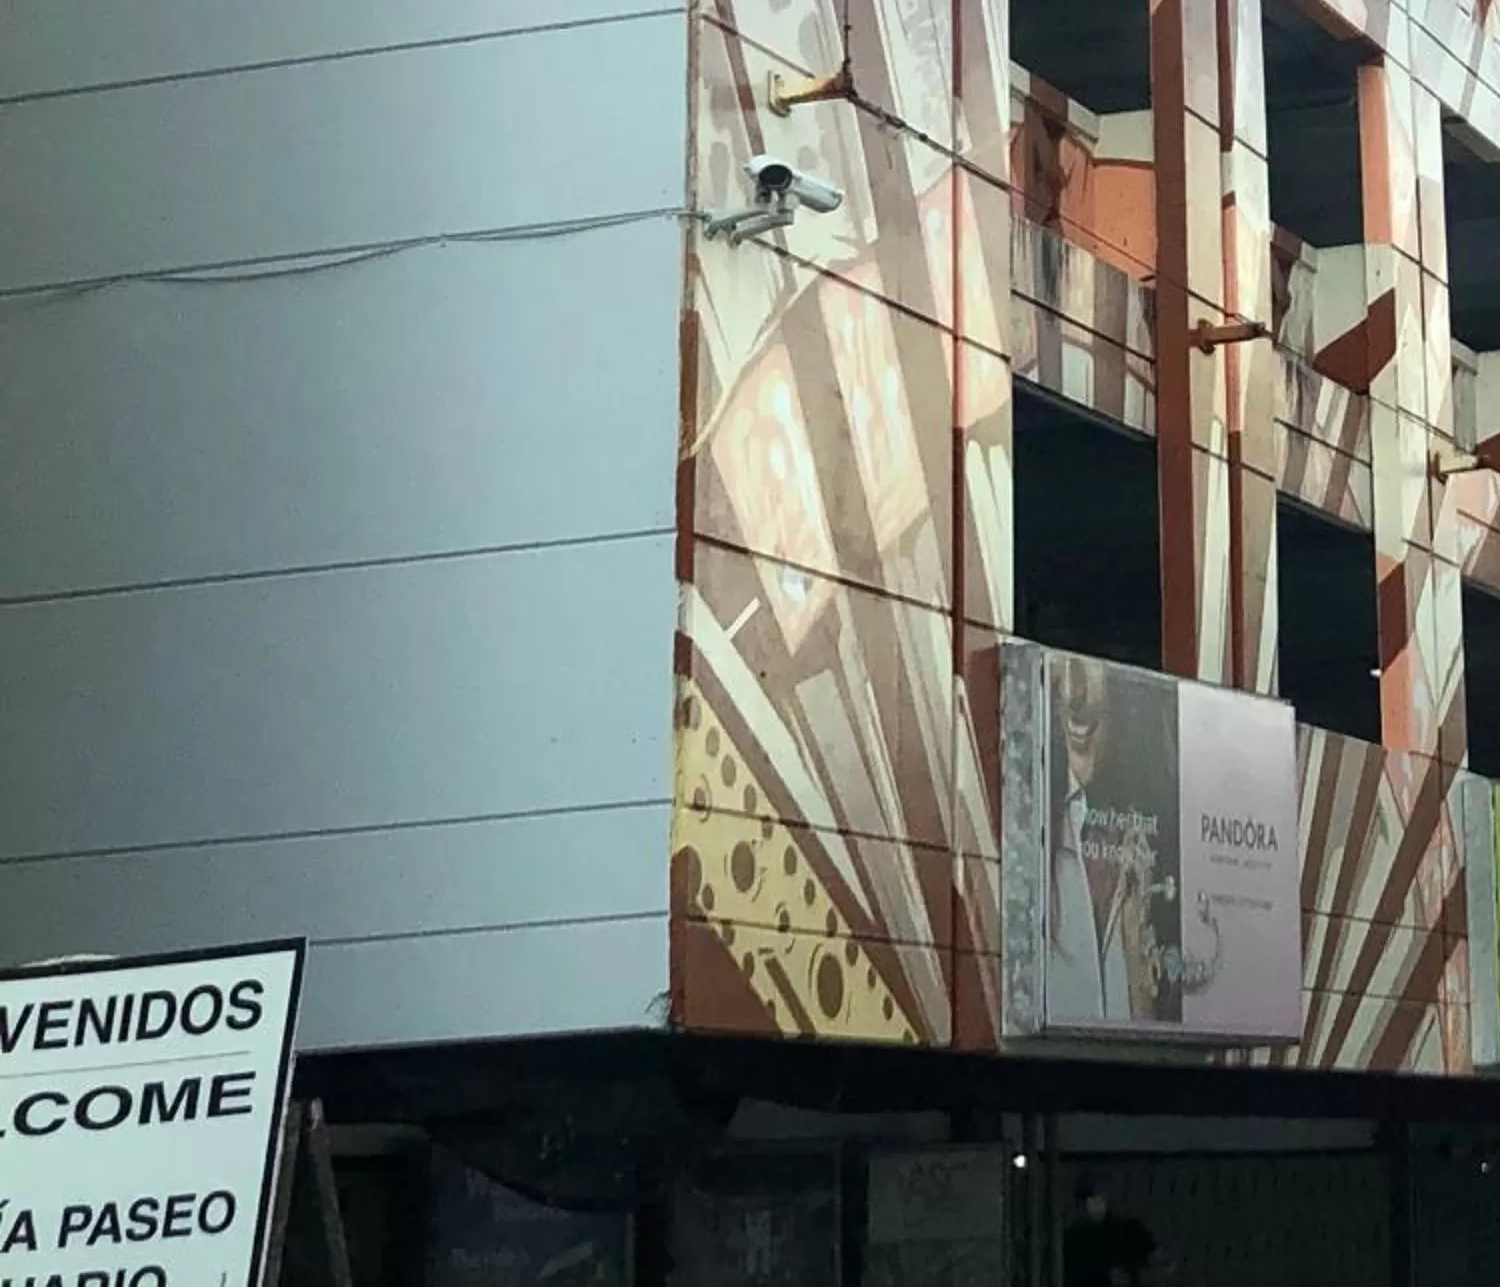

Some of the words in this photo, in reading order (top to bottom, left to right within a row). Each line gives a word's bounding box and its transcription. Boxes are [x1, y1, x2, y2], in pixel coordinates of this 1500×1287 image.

[1200, 813, 1279, 853] PANDORA
[0, 979, 264, 1054] VENIDOS
[0, 1071, 256, 1137] COME
[0, 1199, 37, 1253] A
[58, 1190, 236, 1248] PASEO
